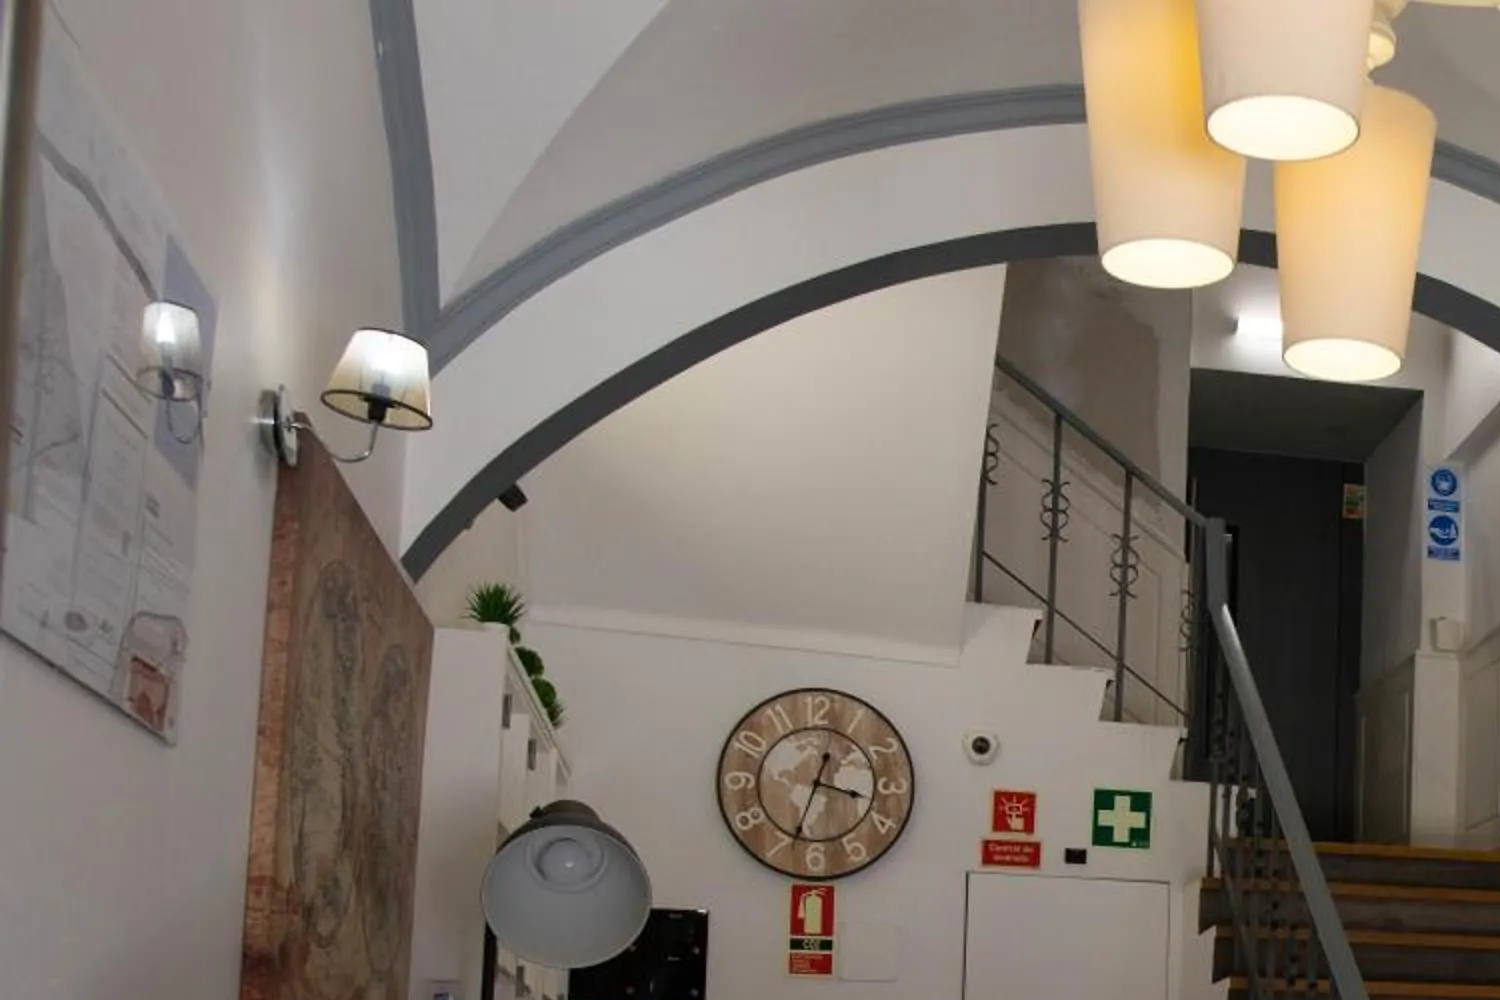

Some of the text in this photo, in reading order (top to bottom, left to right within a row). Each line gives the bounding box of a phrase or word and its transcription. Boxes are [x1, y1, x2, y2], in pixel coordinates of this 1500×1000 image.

[766, 704, 794, 734] 11
[802, 696, 831, 727] 12
[847, 708, 865, 734] 1
[734, 730, 767, 759] 10
[869, 737, 899, 760] 2
[724, 771, 756, 791] 9
[877, 777, 907, 795] 3
[735, 807, 765, 831] 8
[871, 809, 897, 835] 4
[766, 832, 792, 859] 7
[805, 843, 826, 871] 6
[842, 836, 867, 863] 5
